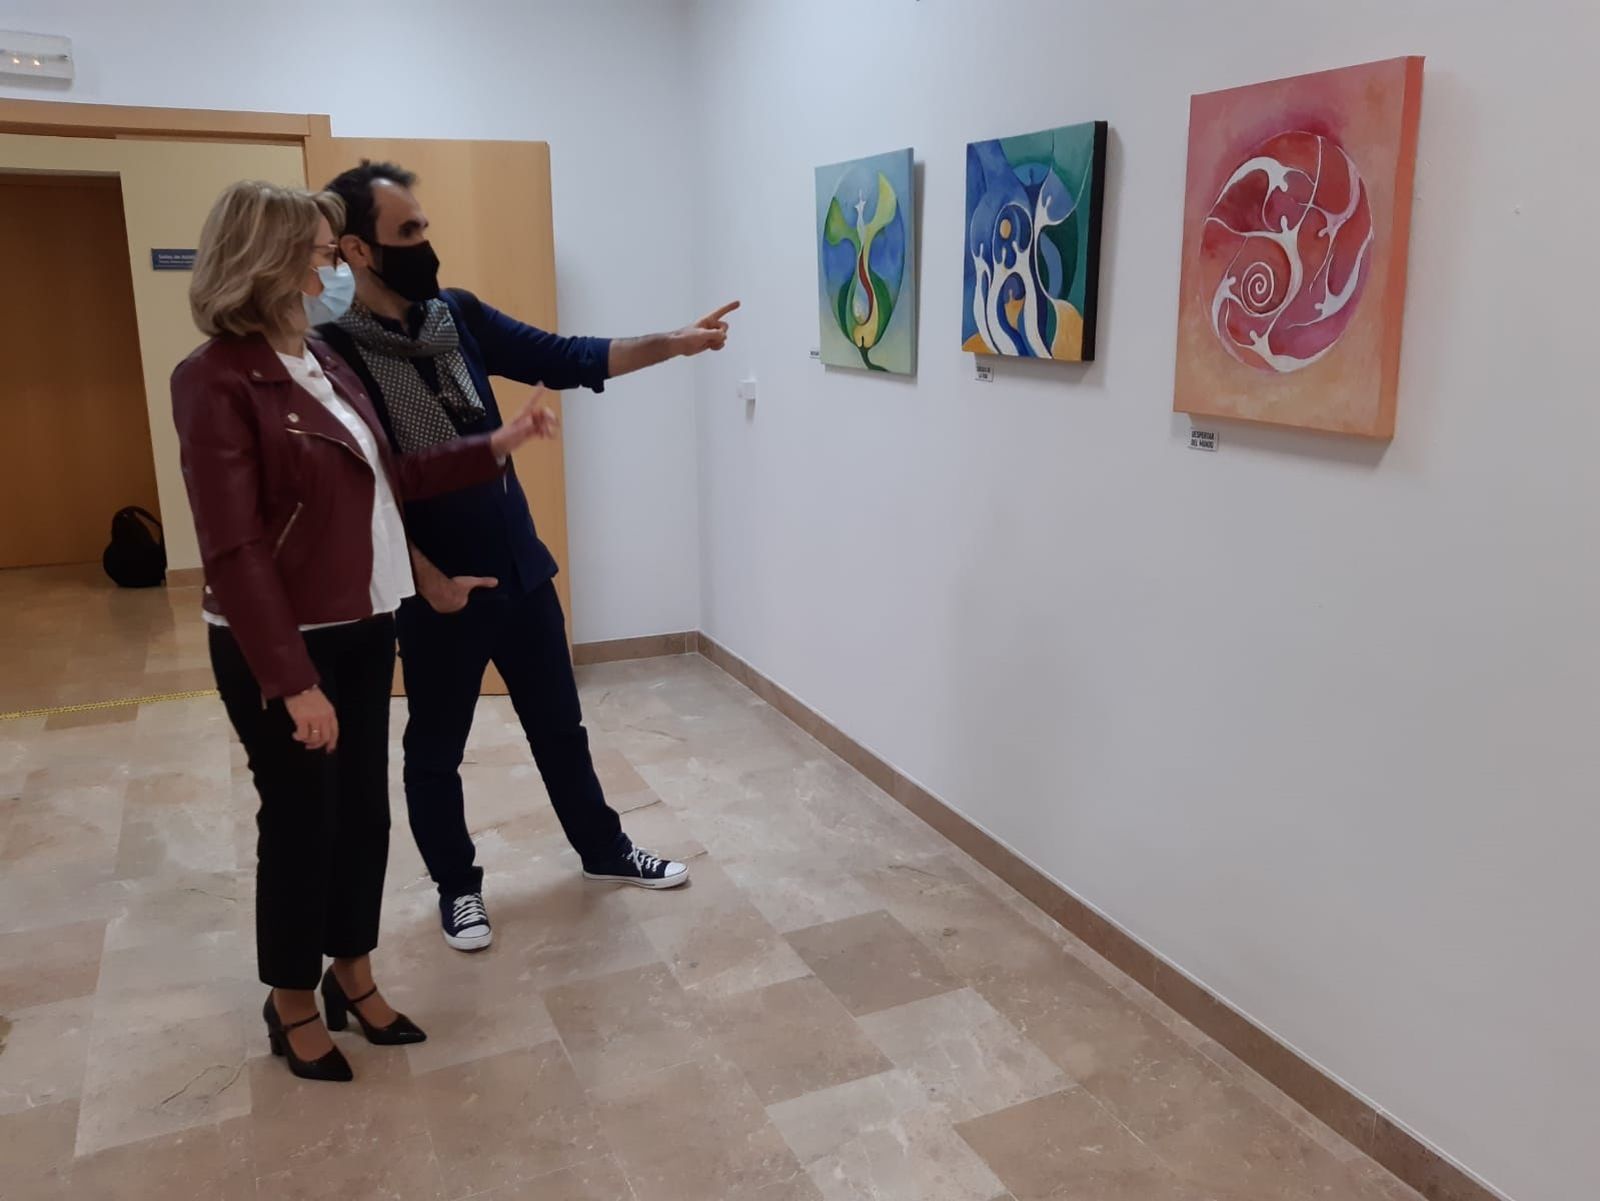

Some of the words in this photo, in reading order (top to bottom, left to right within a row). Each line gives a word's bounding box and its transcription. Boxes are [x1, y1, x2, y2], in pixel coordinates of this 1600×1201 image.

[1191, 430, 1215, 441] DESPERTAR
[1190, 438, 1198, 447] DEL
[1199, 439, 1214, 449] MUNDO
